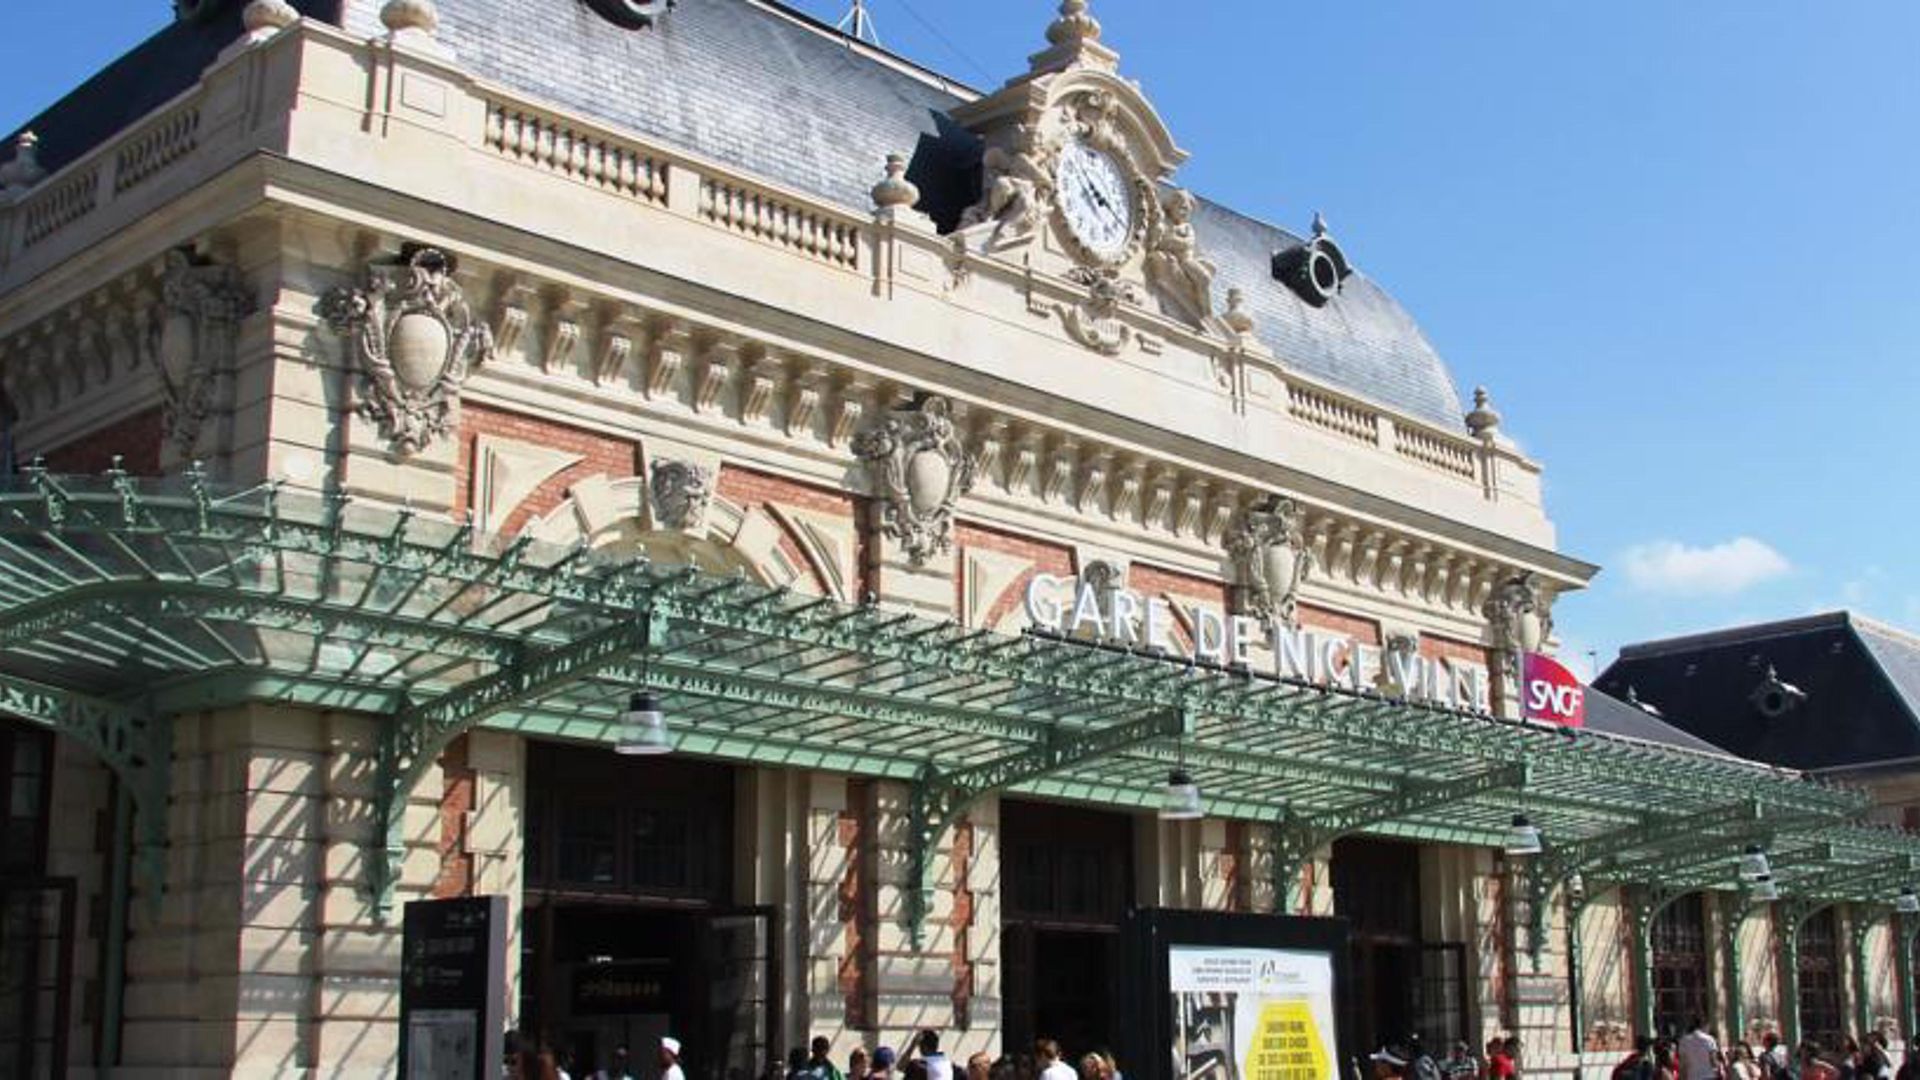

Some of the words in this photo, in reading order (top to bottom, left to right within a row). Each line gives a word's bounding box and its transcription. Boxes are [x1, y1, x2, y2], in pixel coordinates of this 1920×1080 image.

[1027, 573, 1170, 653] GARE
[1192, 607, 1250, 662] DE
[1276, 624, 1379, 692] NICE
[1386, 650, 1490, 714] VILLE
[1528, 680, 1583, 717] SNCF
